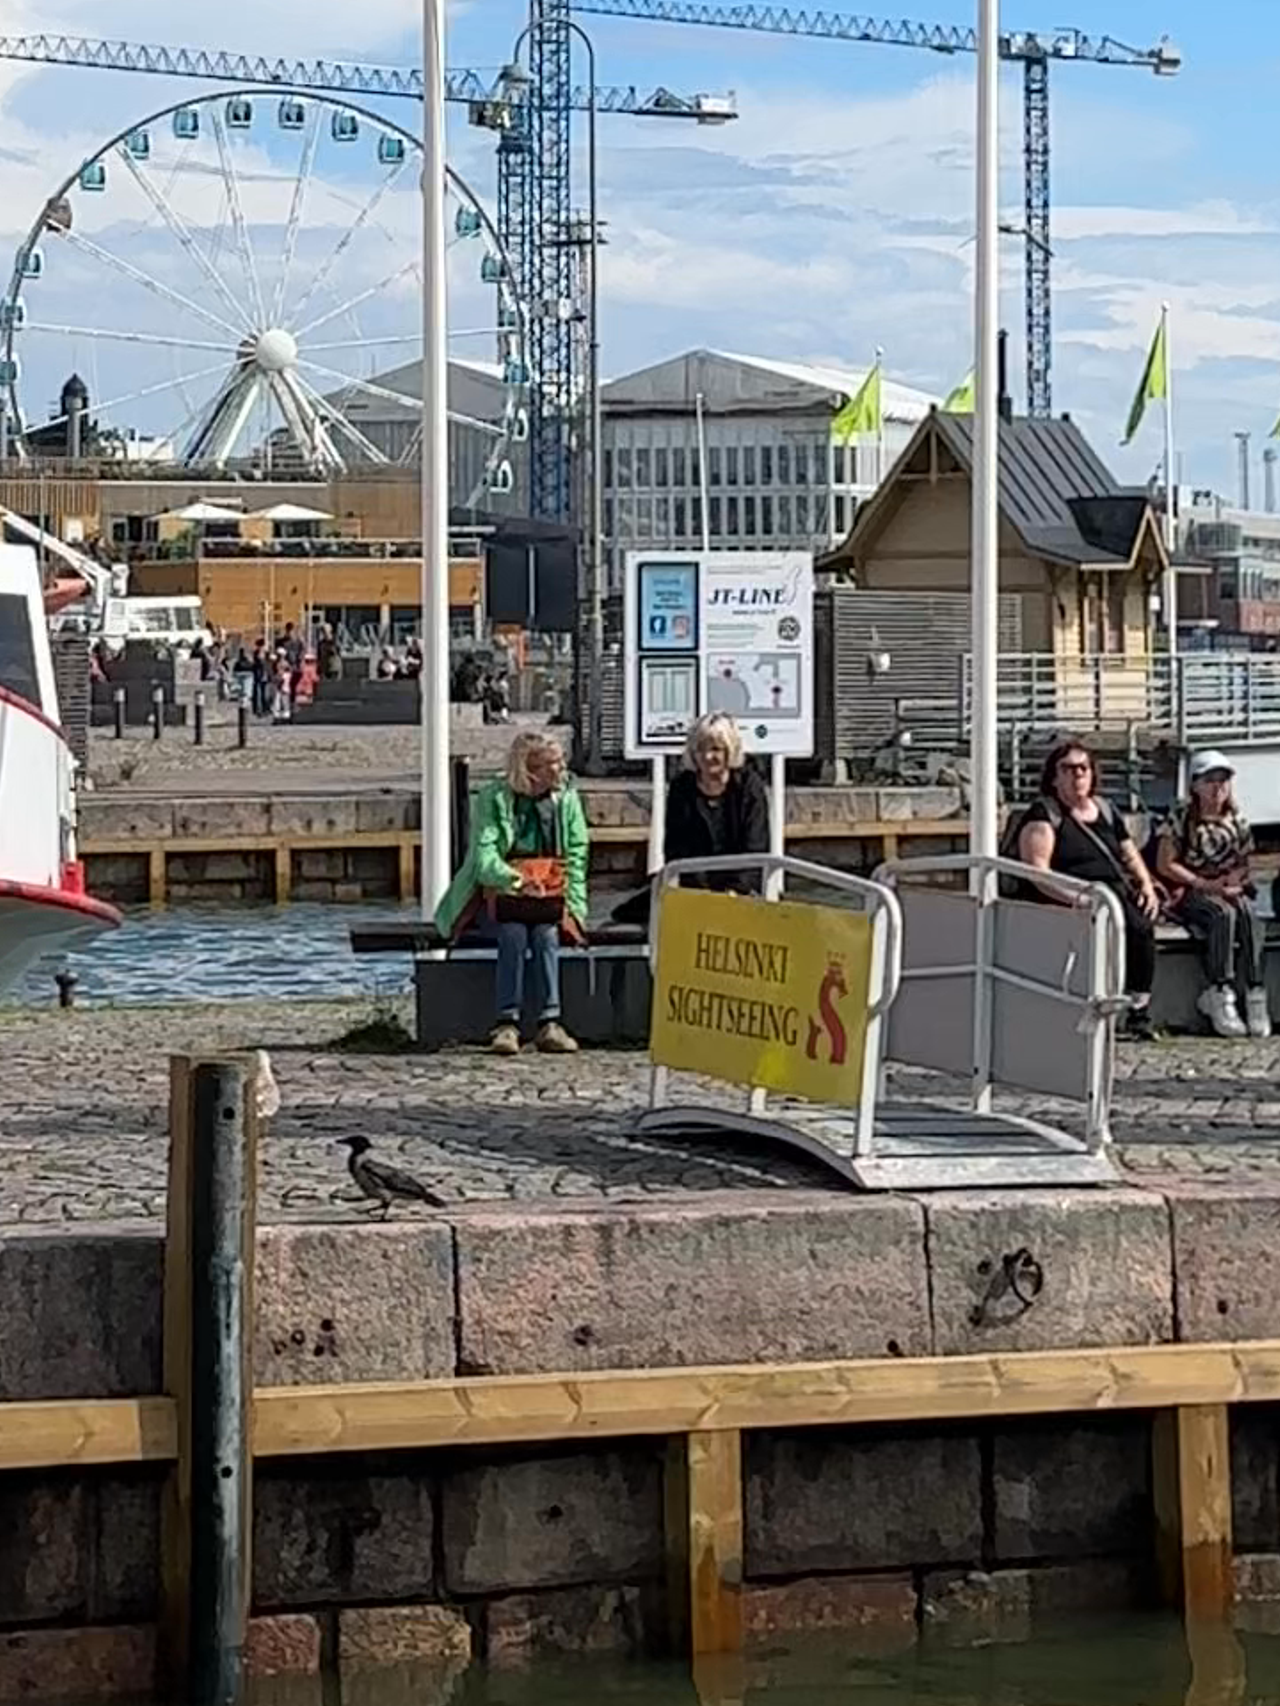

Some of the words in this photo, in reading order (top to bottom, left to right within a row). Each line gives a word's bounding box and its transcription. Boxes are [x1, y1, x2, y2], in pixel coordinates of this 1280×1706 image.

[707, 588, 785, 605] JT-LINE
[695, 932, 789, 985] HELSINKI
[667, 984, 800, 1047] SIGHTSEEING
